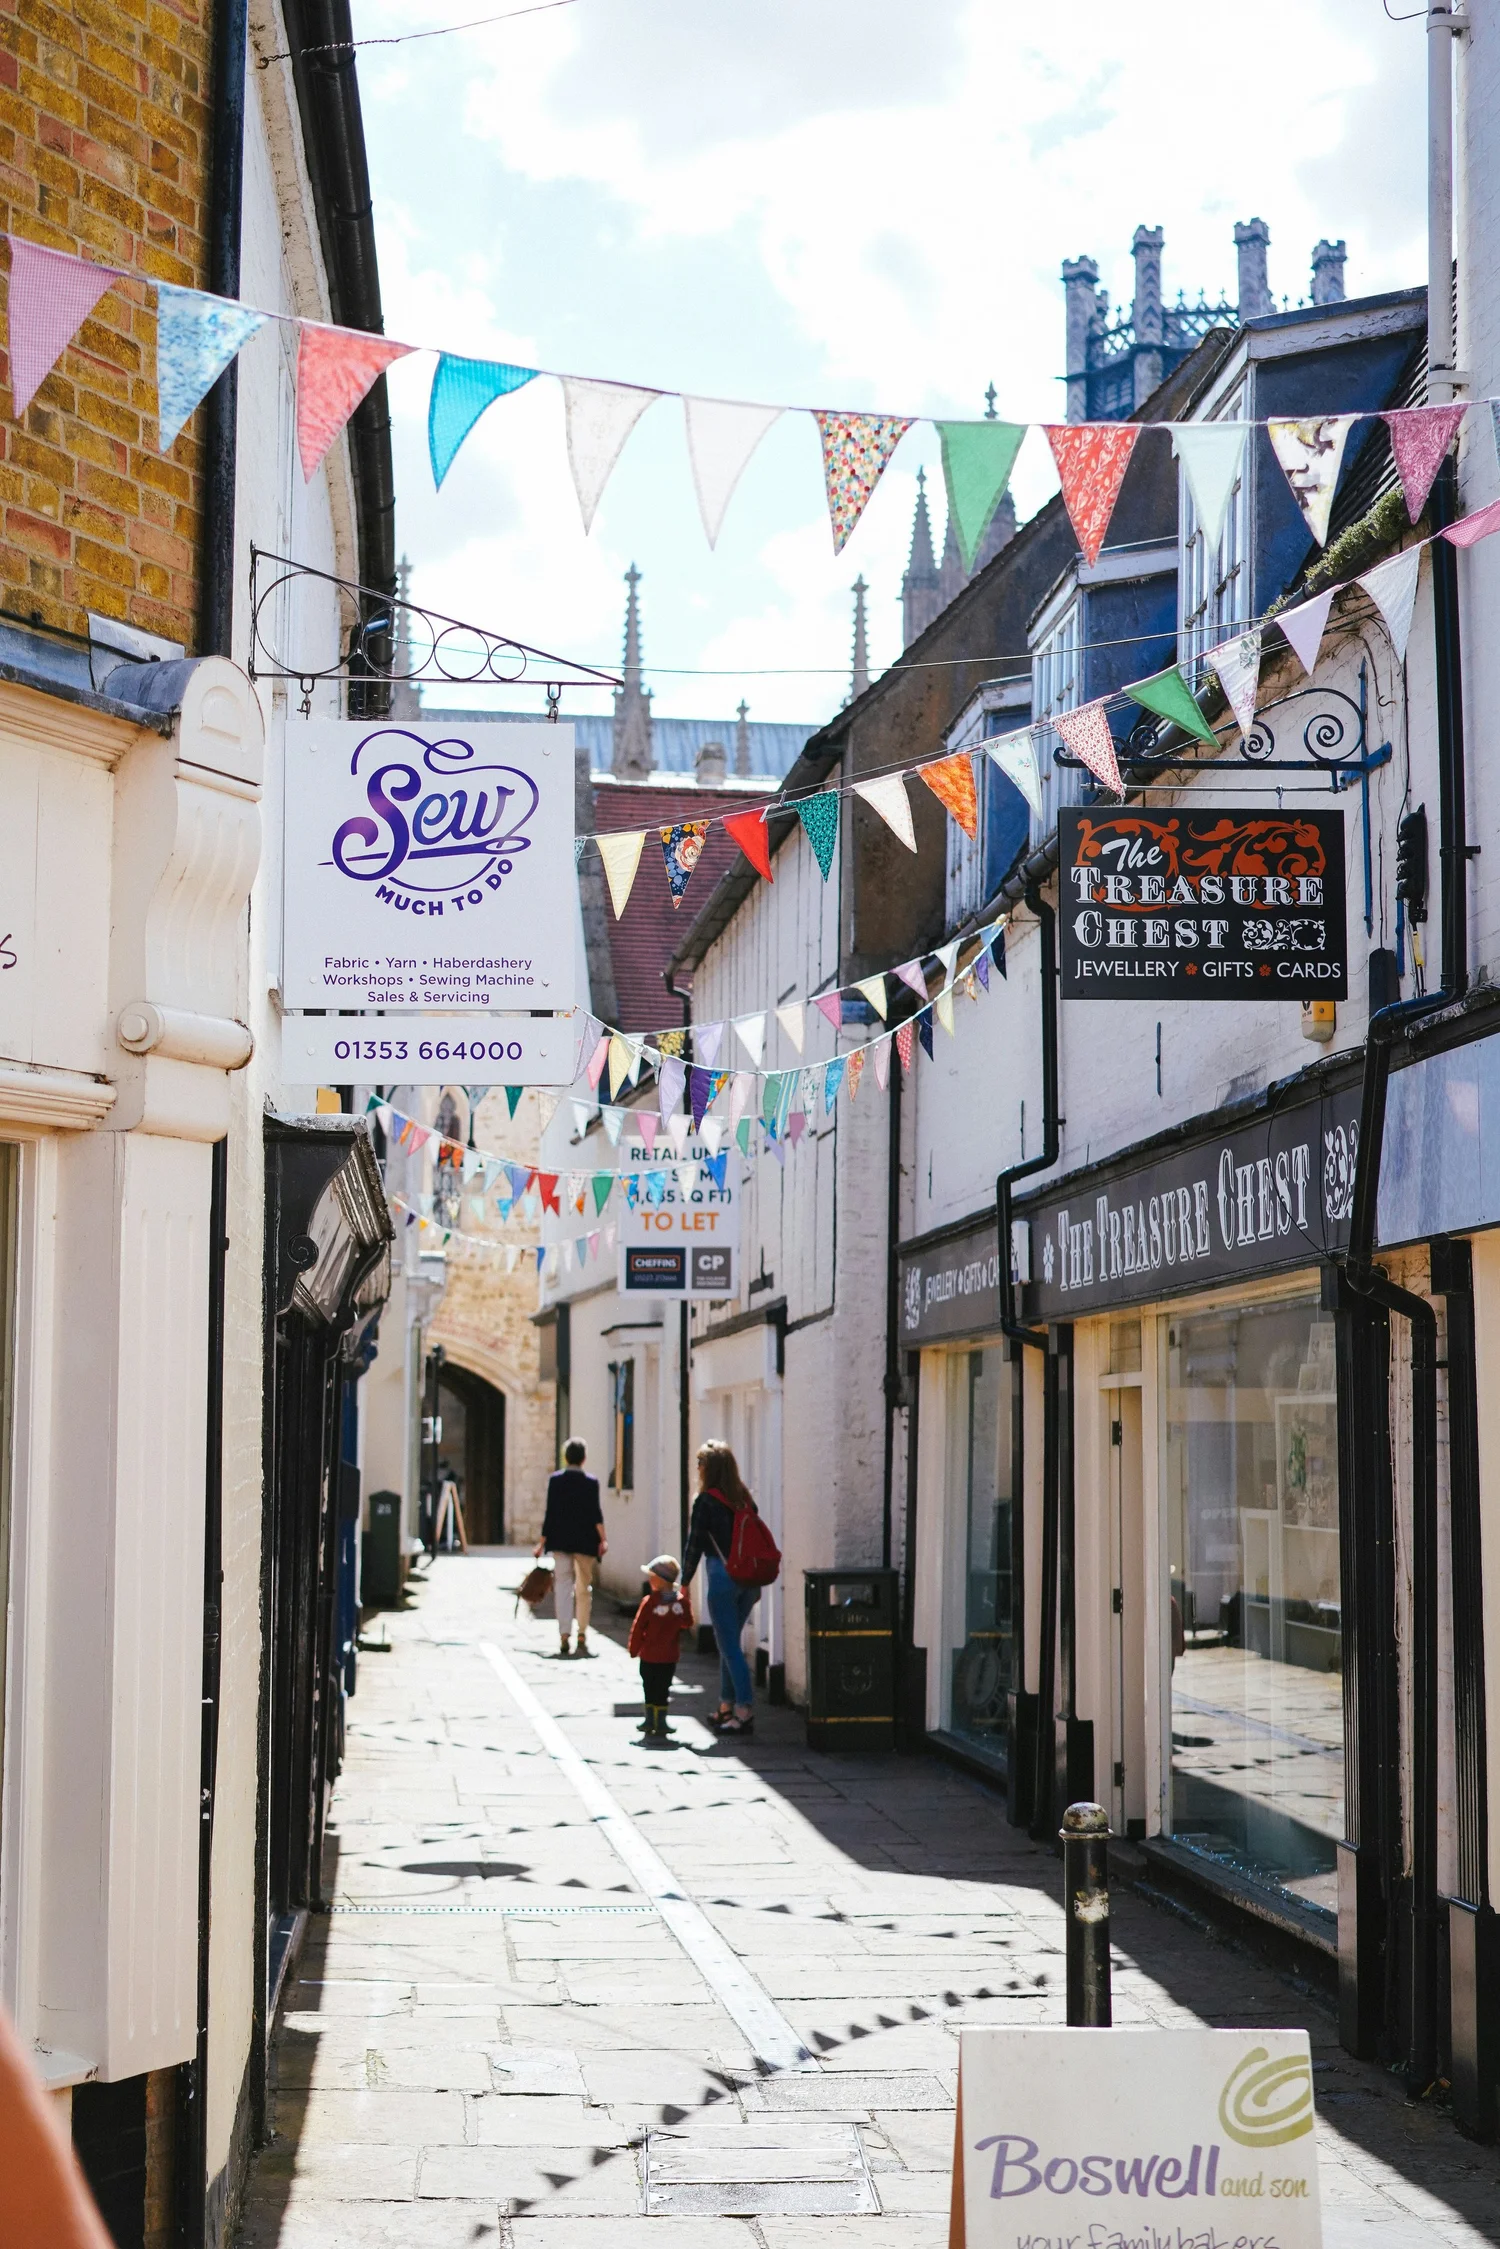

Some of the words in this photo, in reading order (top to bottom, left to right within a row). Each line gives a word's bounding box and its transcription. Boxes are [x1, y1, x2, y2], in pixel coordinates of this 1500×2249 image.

[332, 763, 515, 881] Sew
[1101, 838, 1163, 872] The
[374, 884, 444, 916] MUCH
[451, 889, 483, 911] TO
[485, 858, 513, 890] DO
[1071, 866, 1325, 906] TREASURE
[1072, 910, 1229, 949] CHEST
[324, 957, 369, 969] Fabric
[385, 957, 417, 969] Yarn
[433, 957, 532, 970] Haberdashery
[1075, 958, 1180, 979] JEWELLERY
[1202, 961, 1254, 978] GIFTS
[1276, 962, 1341, 979] CARDS
[323, 973, 403, 988] Workshops
[419, 974, 471, 989] Sewing
[475, 974, 534, 987] Machine
[368, 990, 404, 1003] Sales
[409, 991, 419, 1003] &
[424, 990, 490, 1005] Servicing
[335, 1041, 409, 1060] 01353
[419, 1041, 522, 1060] 664000
[631, 1147, 688, 1161] RETAI
[641, 1212, 673, 1231] TO
[682, 1212, 719, 1231] LET
[1058, 1209, 1093, 1292] THE
[1097, 1180, 1210, 1283] TREASURE
[1217, 1143, 1310, 1250] CHEST
[635, 1258, 677, 1268] CHEFFINS
[698, 1254, 725, 1271] CP
[963, 1260, 982, 1295] GIFTS
[974, 2134, 1221, 2200] Boswell
[1220, 2171, 1266, 2198] and
[1269, 2176, 1311, 2198] son
